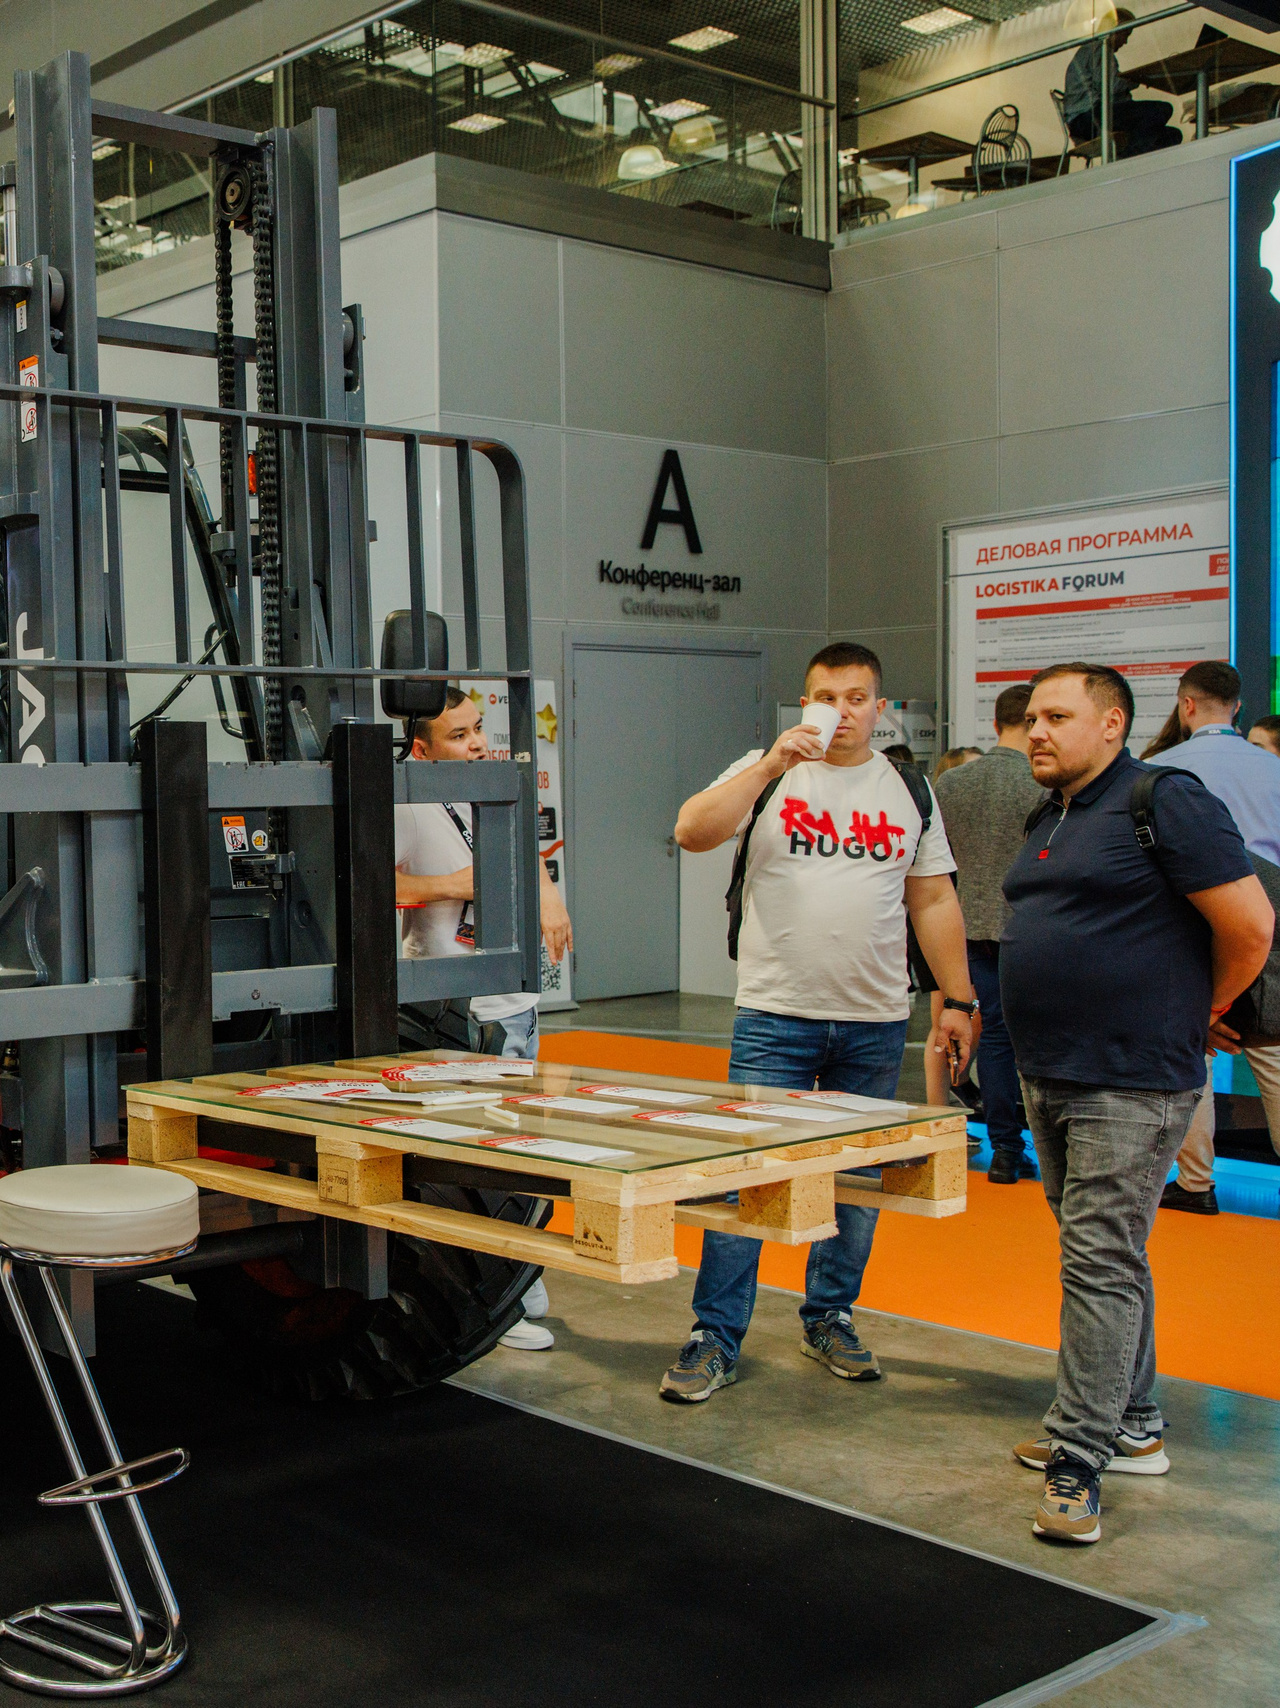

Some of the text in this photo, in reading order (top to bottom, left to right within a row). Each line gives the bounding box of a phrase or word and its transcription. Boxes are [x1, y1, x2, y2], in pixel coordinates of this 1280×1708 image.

[976, 522, 1194, 566] ДЕЛОВАЯ ПРОГРАММА
[598, 559, 742, 593] Конференц-зал
[976, 570, 1125, 599] LOGISTIKA FORUM
[789, 830, 893, 862] HUGO
